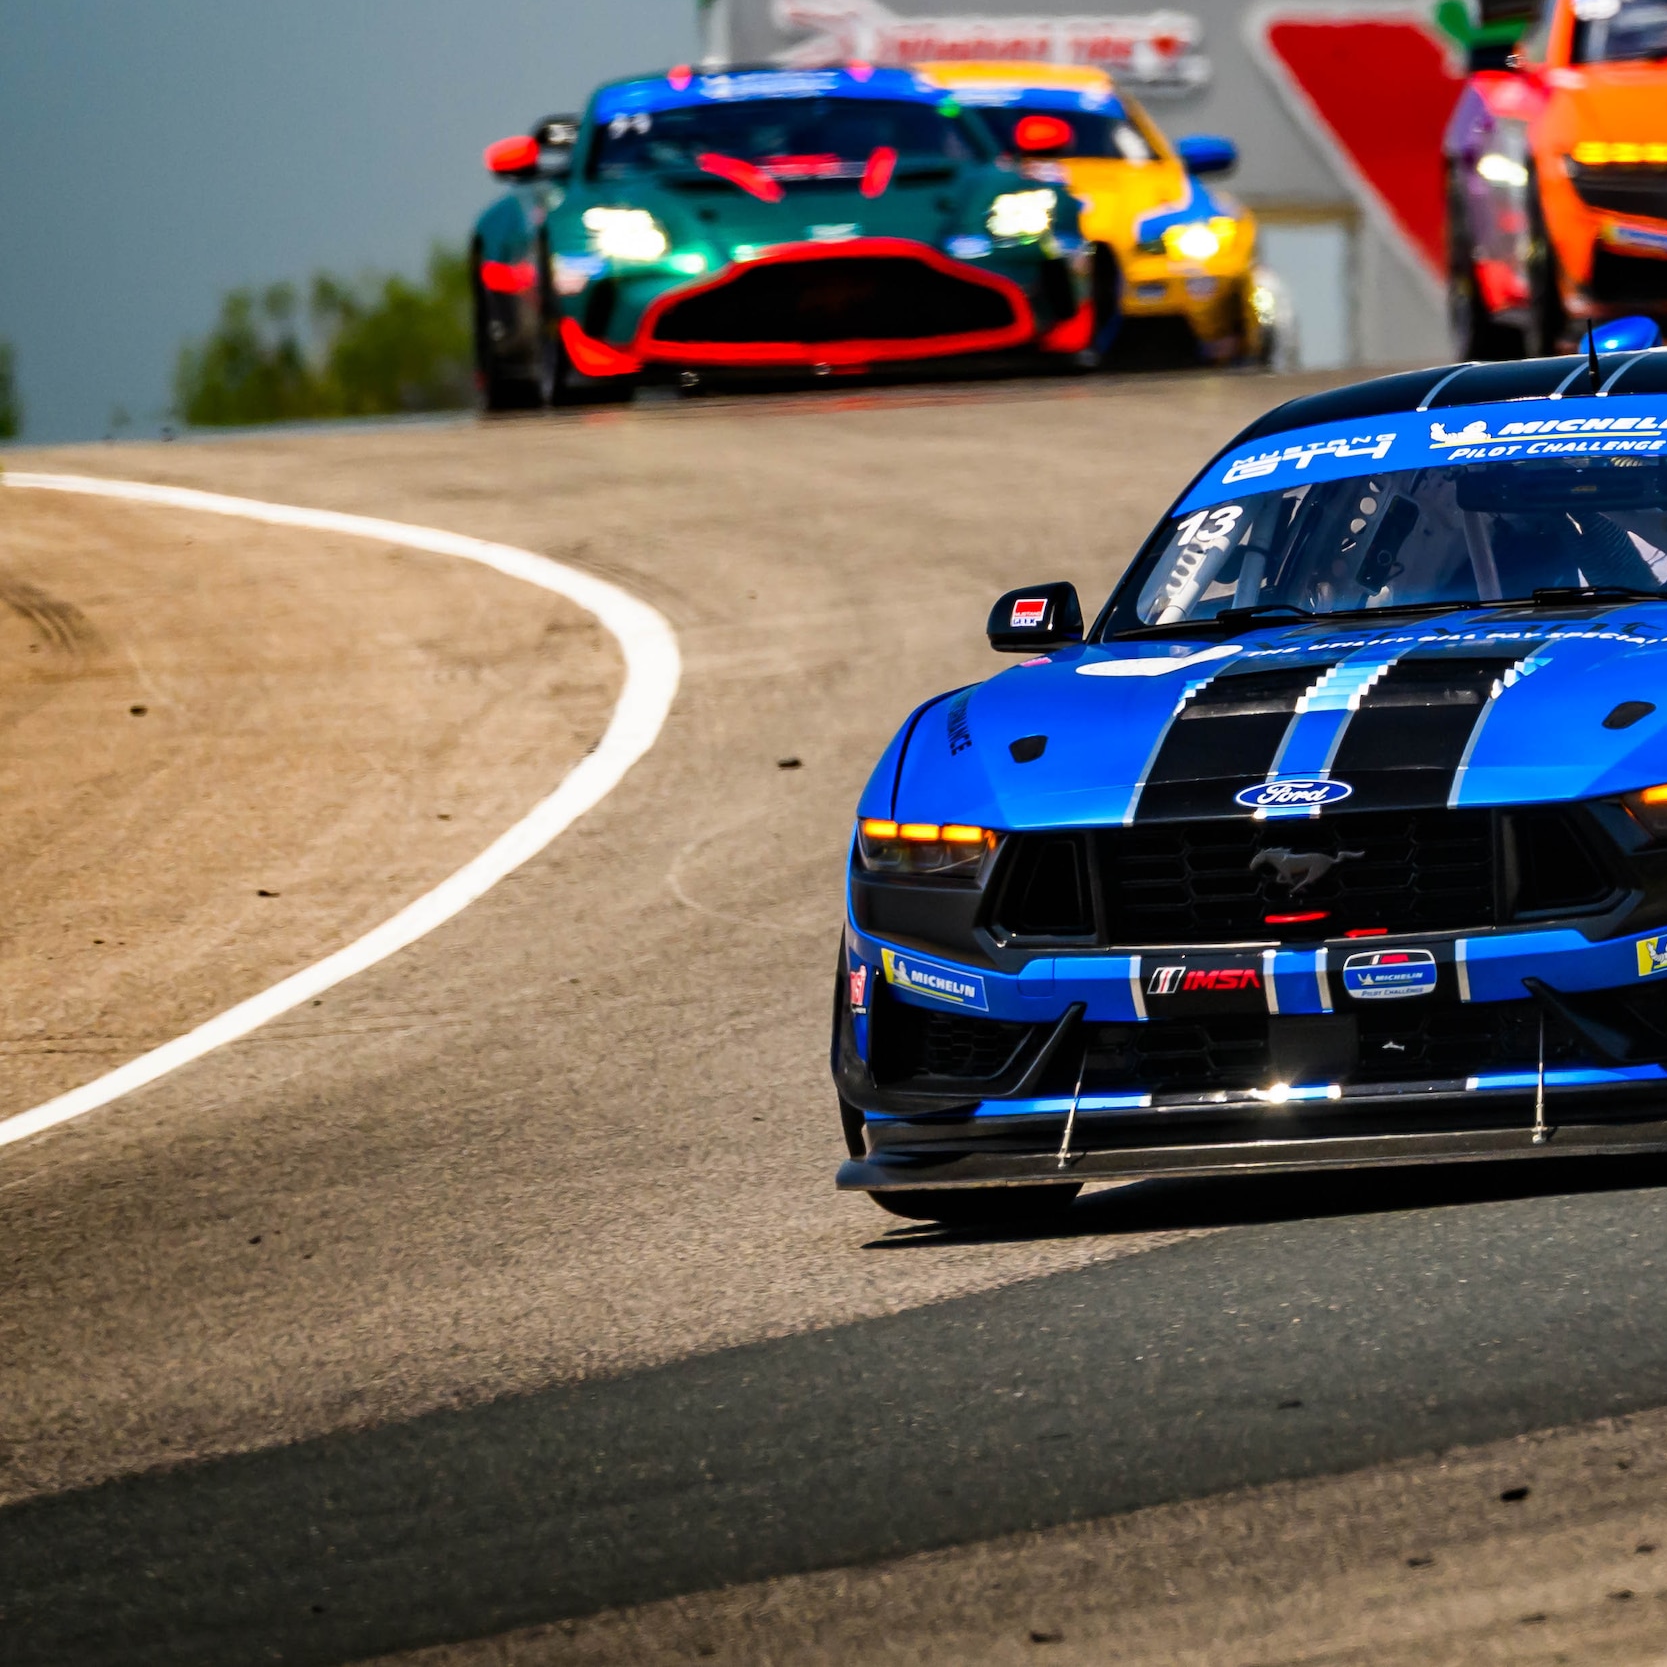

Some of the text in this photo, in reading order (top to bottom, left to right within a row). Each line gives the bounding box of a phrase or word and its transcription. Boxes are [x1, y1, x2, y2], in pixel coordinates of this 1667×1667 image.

[1447, 439, 1667, 461] PILOT CHALLENGE
[1177, 505, 1244, 546] 13
[1257, 782, 1330, 804] Ford
[911, 970, 976, 998] MICHELIN
[1183, 969, 1260, 990] IMSA
[1375, 972, 1424, 982] MICHELIN
